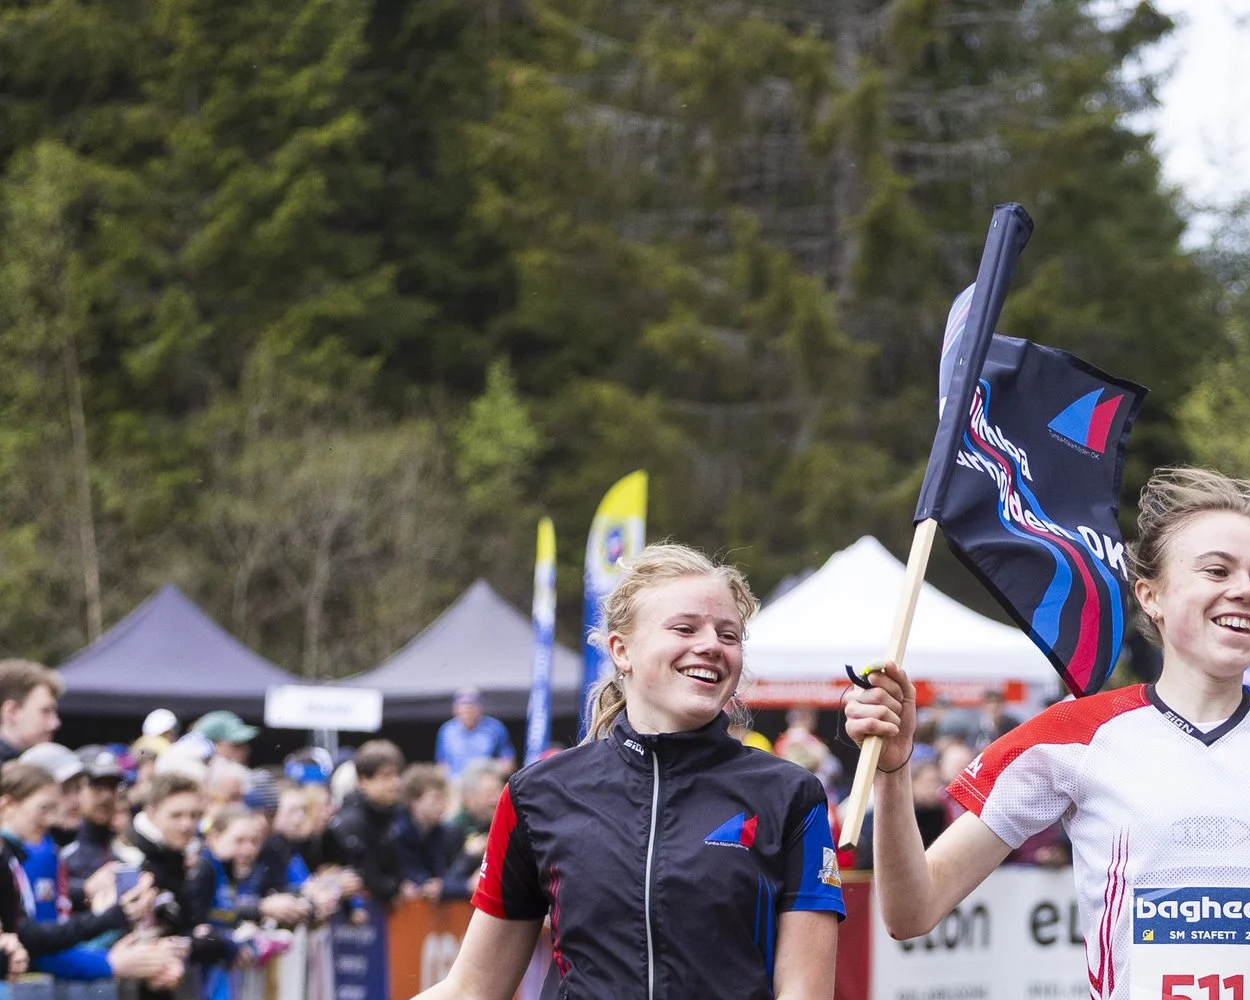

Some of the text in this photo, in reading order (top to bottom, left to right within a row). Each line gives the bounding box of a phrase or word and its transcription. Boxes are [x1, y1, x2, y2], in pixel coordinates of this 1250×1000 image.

[956, 450, 1129, 582] arhöjden OK
[1169, 930, 1185, 940] SM
[1191, 930, 1237, 940] STAFETT
